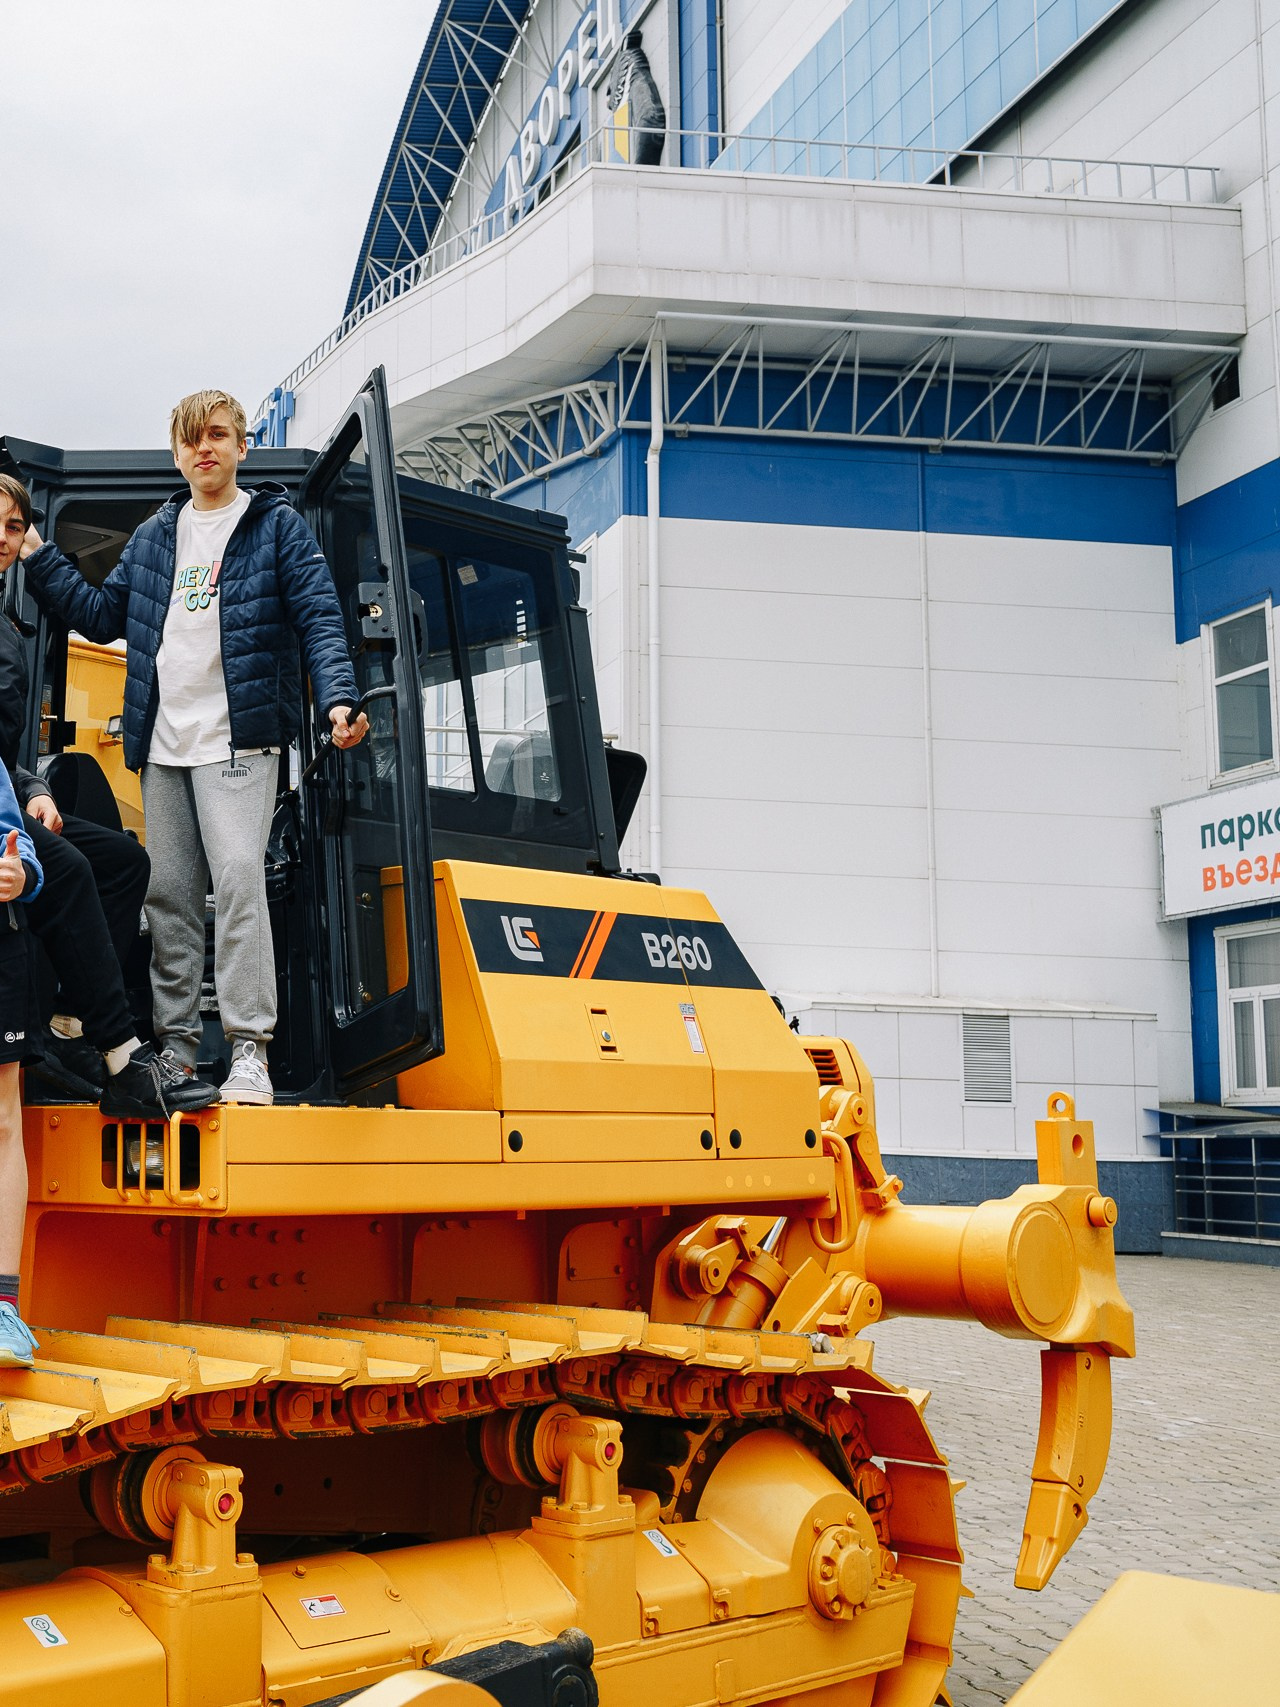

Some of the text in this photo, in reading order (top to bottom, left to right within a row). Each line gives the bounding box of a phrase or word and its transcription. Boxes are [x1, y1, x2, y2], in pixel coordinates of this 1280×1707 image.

[185, 588, 211, 612] GO
[222, 769, 248, 778] PUMA
[640, 932, 712, 971] B260
